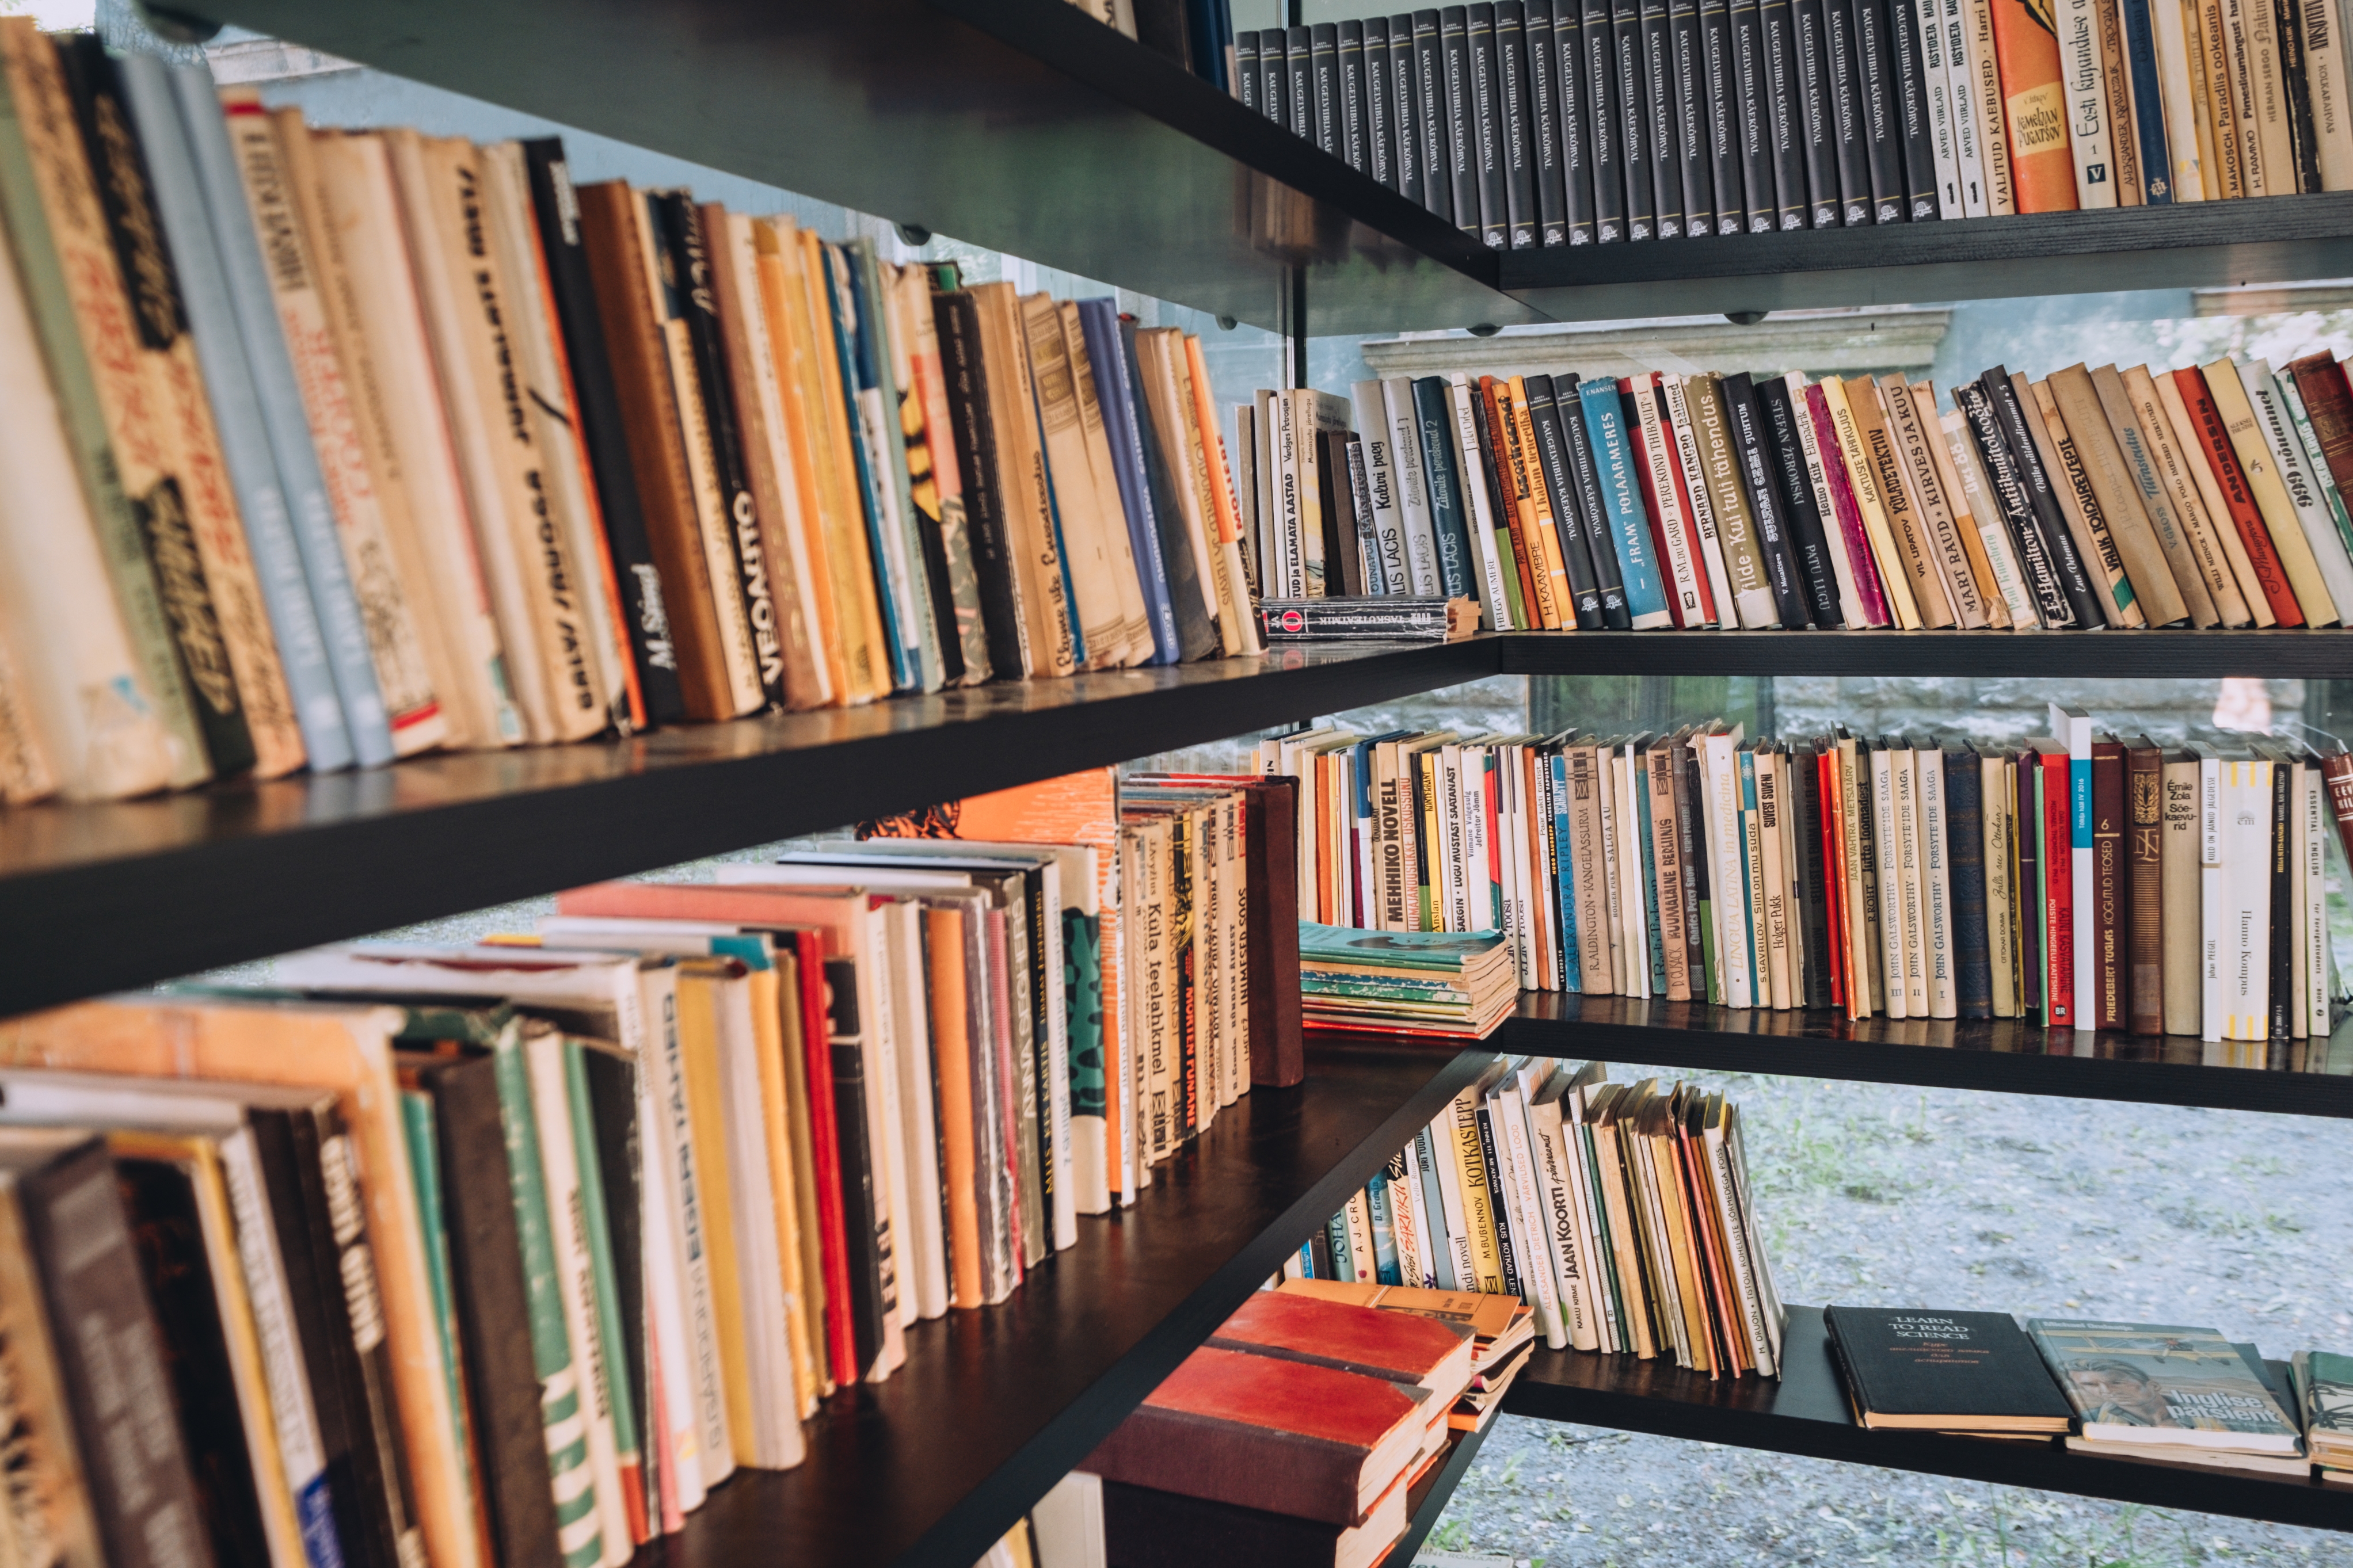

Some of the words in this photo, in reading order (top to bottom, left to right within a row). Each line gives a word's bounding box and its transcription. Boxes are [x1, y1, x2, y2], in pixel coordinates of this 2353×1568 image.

[1926, 23, 1940, 68] RISTIDETA
[1950, 21, 1964, 67] RISTIDETA
[2205, 4, 2222, 69] ookeanis
[1934, 86, 1944, 126] VIIRLAID
[1958, 85, 1969, 125] VIIRLAID
[1982, 59, 2000, 135] KAEBUSED
[2214, 73, 2230, 127] Paradiis
[2076, 98, 2099, 137] Eesti
[1938, 128, 1950, 159] ARVED
[1962, 127, 1973, 158] ARVED
[2245, 130, 2260, 176] RAMMO
[1991, 141, 2008, 205] VALITUD
[1586, 384, 1616, 395] F.NANSEN
[1667, 383, 1690, 429] Jäälätted
[1890, 387, 1911, 421] KUU
[1281, 399, 1289, 432] Petrosjan
[1459, 407, 1473, 429] Urbel
[1644, 407, 1661, 451] THIBAULT
[1737, 403, 1755, 444] JUHTUM
[1771, 399, 1790, 445] STEFAN
[2145, 402, 2165, 440] SEIKLUSED
[1283, 434, 1291, 463] Vardges
[1902, 422, 1919, 444] JA
[1371, 441, 1389, 466] poeg
[1601, 412, 1633, 514] POLAARMERES
[1680, 434, 1701, 482] KANGRO
[2160, 442, 2179, 476] IMELISED
[2196, 398, 2247, 504] ANDERSEN
[1653, 454, 1674, 509] PEREKOND
[1808, 461, 1824, 484] Kiik
[1911, 447, 1940, 508] KIRVES
[2030, 465, 2047, 493] Väike
[2176, 478, 2188, 499] POLO
[1285, 473, 1296, 514] AASTAD
[1815, 487, 1832, 517] Heino
[1693, 484, 1716, 540] BERNARD
[2156, 506, 2175, 538] GROSS
[2184, 501, 2201, 529] MARCO
[1287, 517, 1299, 567] ELAMATA
[1668, 518, 1683, 545] GARD
[1722, 513, 1743, 547] Kui
[1901, 518, 1921, 559] LIPATOV
[1937, 520, 1961, 569] RAUD
[1805, 544, 1822, 574] PATU
[2058, 535, 2078, 574] Vetemaa
[2199, 537, 2215, 566] MEINCK
[1486, 558, 1500, 591] AUMERE
[1530, 540, 1549, 600] KÄÄMBRE
[1913, 560, 1925, 578] VIL
[2211, 568, 2224, 592] WILLI
[1491, 594, 1506, 628] HELGA
[1544, 602, 1553, 616] H.
[1813, 578, 1830, 610] LUGU
[1957, 578, 1978, 614] MART
[1446, 766, 1460, 818] SAATANAST
[1554, 779, 1568, 814] SCARLETT
[1761, 773, 1774, 799] SUVENI
[1881, 769, 1889, 802] SAAGA
[1899, 768, 1909, 800] SAAGA
[1926, 769, 1936, 802] SAAGA
[2167, 780, 2192, 792] Émile
[2170, 791, 2191, 800] Zola
[2206, 777, 2217, 807] JÄLGEDESSE
[1381, 778, 1399, 842] NOVELL
[1464, 791, 1472, 820] Valgesulg
[1602, 806, 1612, 821] AU
[1763, 800, 1776, 829] SUVEST
[1857, 781, 1872, 841] loomadest
[2207, 810, 2217, 833] JÄÄNUD
[2309, 791, 2317, 833] ESSENTIAL
[1749, 823, 1759, 853] süda
[1846, 823, 1859, 860] VAHTRA
[2101, 819, 2109, 830] 6
[2174, 821, 2186, 830] rid
[1450, 821, 1461, 863] MUSTAST
[1558, 827, 1570, 873] RIPLEY
[1578, 807, 1594, 892] KANGELASSURM
[1604, 825, 1616, 863] SALGA
[1659, 818, 1678, 869] BERLIINIS
[1860, 843, 1874, 873] Jutte
[2101, 840, 2112, 878] TEOSED
[2311, 842, 2319, 876] ENGLISH
[1453, 863, 1463, 887] LUGU
[1751, 856, 1760, 875] mu
[1850, 861, 1859, 882] JAAN
[1384, 844, 1403, 922] MEHHIKO
[1725, 859, 1738, 910] LATINA
[1754, 878, 1761, 892] on
[1664, 869, 1681, 940] KUUMALAINE
[1753, 895, 1762, 914] Siin
[1771, 894, 1783, 918] Pukk
[1886, 882, 1899, 950] GALSWORTHY
[1905, 880, 1920, 949] GALSWORTHY
[1932, 881, 1946, 950] GALSWORTHY
[2101, 880, 2114, 924] KOGUTUD
[1563, 883, 1577, 967] ALEXANDRA
[1727, 913, 1744, 970] LINGUA
[1773, 921, 1786, 950] Holger
[2240, 910, 2252, 947] Hanno
[2050, 925, 2058, 960] HINGEELU
[2103, 928, 2114, 964] TUGLAS
[2207, 939, 2215, 959] PEEGEL
[1891, 952, 1902, 980] JOHN
[1910, 952, 1921, 979] JOHN
[1936, 952, 1948, 980] JOHN
[2051, 962, 2059, 1001] KAITSMINE
[2207, 962, 2217, 979] Juhan
[2240, 952, 2252, 997] Kompus
[2104, 967, 2116, 1022] FRIEDEBERT
[1455, 1098, 1484, 1189] KOTKASTEPP
[1715, 1147, 1727, 1176] POISS
[1548, 1187, 1571, 1242] KOORTI
[1455, 1236, 1472, 1273] novell
[1501, 1242, 1513, 1274] KOTKAD
[1731, 1221, 1746, 1263] ROHELISTE
[1563, 1244, 1581, 1280] JAAN
[1751, 1310, 1762, 1338] DRUON
[1897, 1332, 1970, 1340] SCIENCE
[2166, 1405, 2281, 1424] patsient
[2169, 1390, 2266, 1409] Inglise
